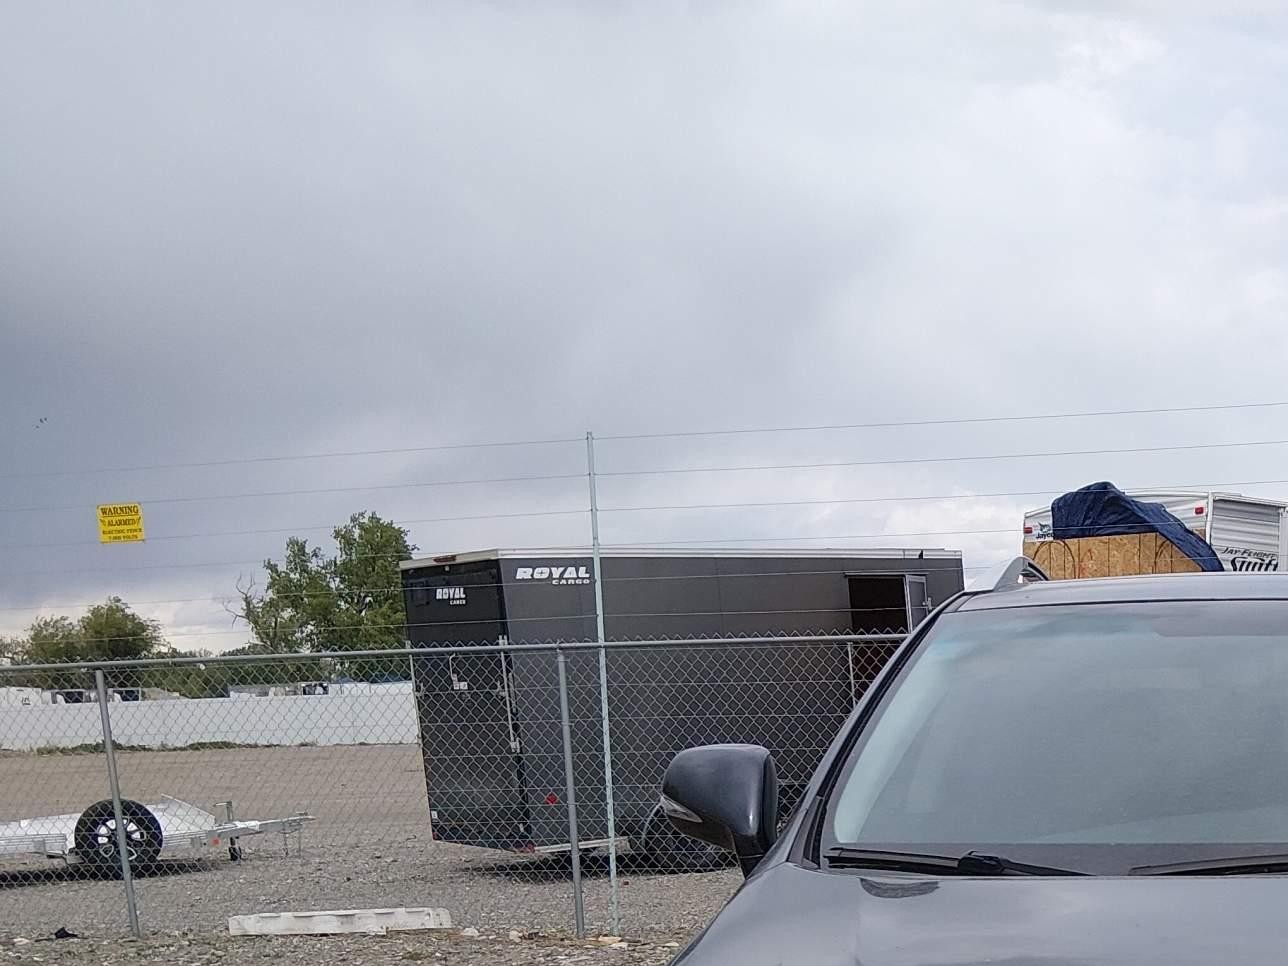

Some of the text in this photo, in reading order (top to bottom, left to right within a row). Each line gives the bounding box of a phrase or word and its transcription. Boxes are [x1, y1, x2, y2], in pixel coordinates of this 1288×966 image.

[100, 506, 139, 515] WARNING
[516, 567, 590, 579] ROYAL
[436, 588, 466, 599] ROYAL
